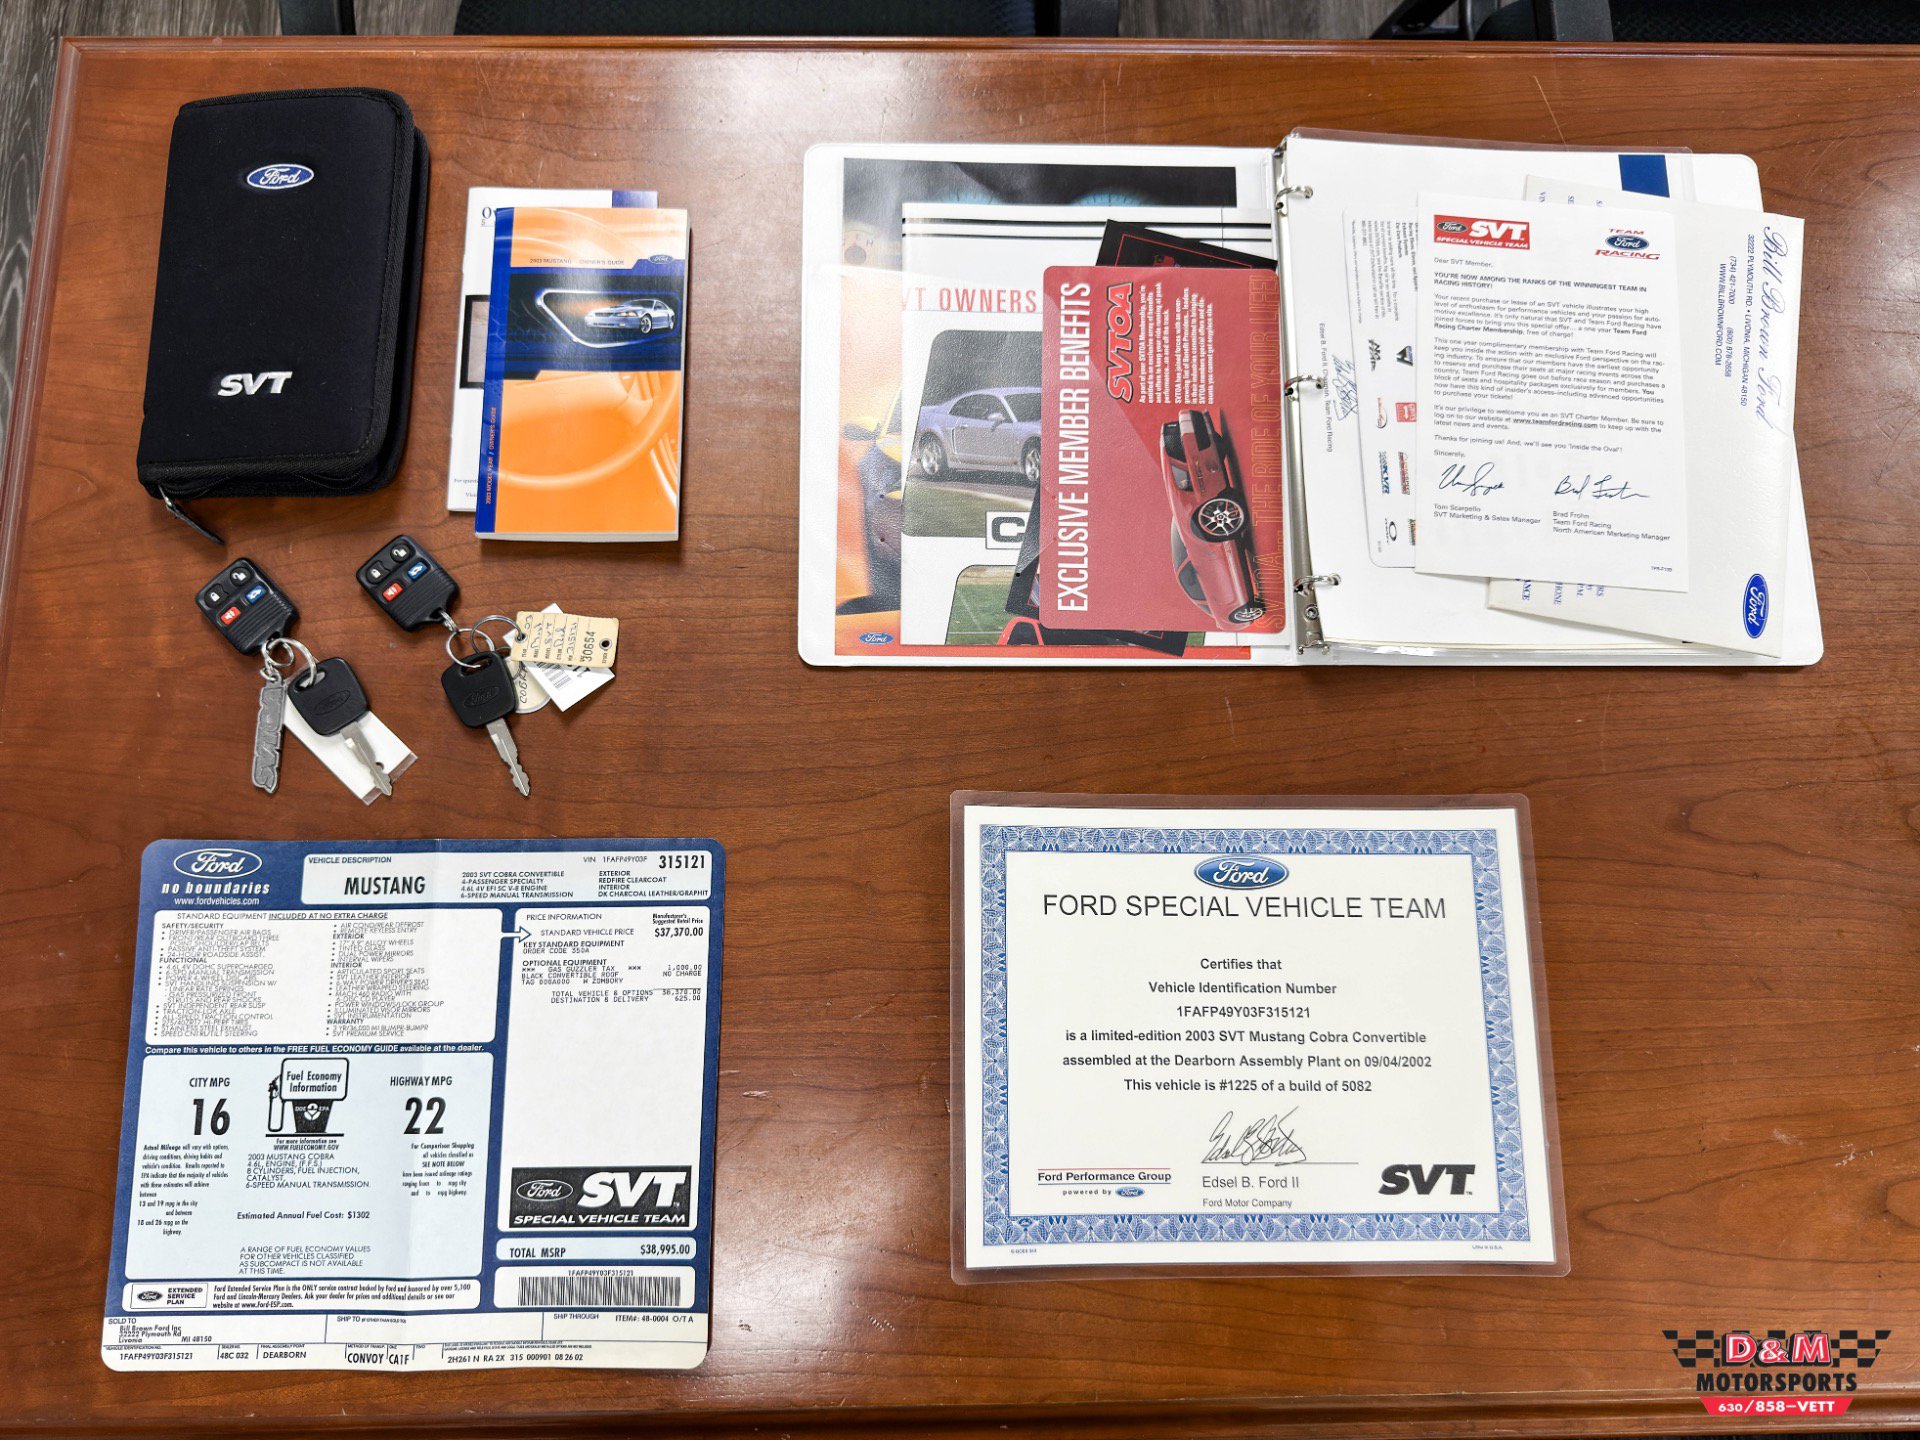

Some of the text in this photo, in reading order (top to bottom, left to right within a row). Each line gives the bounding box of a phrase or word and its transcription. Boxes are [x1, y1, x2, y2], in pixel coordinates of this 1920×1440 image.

[1470, 221, 1527, 241] SVT
[1436, 236, 1469, 245] SPECIAL
[1470, 239, 1502, 247] VEHICLE
[1595, 249, 1660, 260] RACING
[1729, 256, 1737, 273] (734)
[938, 287, 1037, 313] OWNERS
[1755, 226, 1789, 429] Bill Brown Ford
[1106, 281, 1134, 403] SVTOA
[218, 371, 293, 396] SVT
[1057, 282, 1091, 612] EXCLUSIVE MEMBER BENEFITS
[341, 856, 392, 864] DESCRIPTION
[659, 855, 705, 869] 315121
[162, 881, 270, 895] no boundaries
[344, 876, 425, 895] MUSTANG
[174, 897, 260, 906] www.fordvehicles.com
[1042, 893, 1447, 920] FORD SPECIAL VEHICLE TEAM
[526, 913, 546, 921] PRICE
[613, 928, 634, 936] PRICE
[654, 927, 704, 938] $37,370.00
[1199, 958, 1282, 970] Certifies that
[1148, 982, 1337, 995] Vehicle Identification Number
[1176, 1005, 1311, 1018] 1FAFP49Y03F315121
[1065, 1030, 1427, 1045] is a limited-edition 2003 SVT Mustang Cobra Convertible
[145, 1046, 181, 1055] Compare
[183, 1046, 198, 1054] this
[199, 1045, 228, 1054] vehicle
[238, 1045, 263, 1053] others
[264, 1045, 272, 1053] in
[273, 1045, 286, 1053] the
[374, 1044, 399, 1052] GUIDE
[400, 1044, 431, 1052] available
[443, 1044, 455, 1052] the
[457, 1044, 484, 1052] dealer.
[1062, 1055, 1432, 1070] assembled at the Dearborn Assembly Plant on 09/04/2002
[189, 1077, 230, 1087] CITY MPG
[287, 1071, 342, 1083] Fuel Economy
[390, 1076, 453, 1087] HIGHWAY MPG
[290, 1083, 337, 1093] Information
[1124, 1079, 1372, 1092] This vehicle is #1225 of a build of 5082
[192, 1098, 231, 1135] 16
[403, 1096, 447, 1135] 22
[1037, 1171, 1172, 1185] Ford Performance Group
[1202, 1176, 1299, 1189] Edsel B. Ford II
[1377, 1163, 1476, 1195] SVT
[577, 1171, 687, 1208] SVT
[1062, 1189, 1099, 1198] powered
[1102, 1188, 1112, 1198] by
[1202, 1198, 1293, 1210] Ford Motor Company
[237, 1211, 370, 1219] Estimated Annual Fuel Cost: $1302
[513, 1213, 686, 1225] SPECIAL VEHICLE TEAM
[509, 1247, 566, 1258] TOTAL MSRP
[640, 1244, 690, 1255] $38,995.00
[262, 1351, 307, 1359] DEARBORN
[347, 1353, 384, 1364] CONVOY
